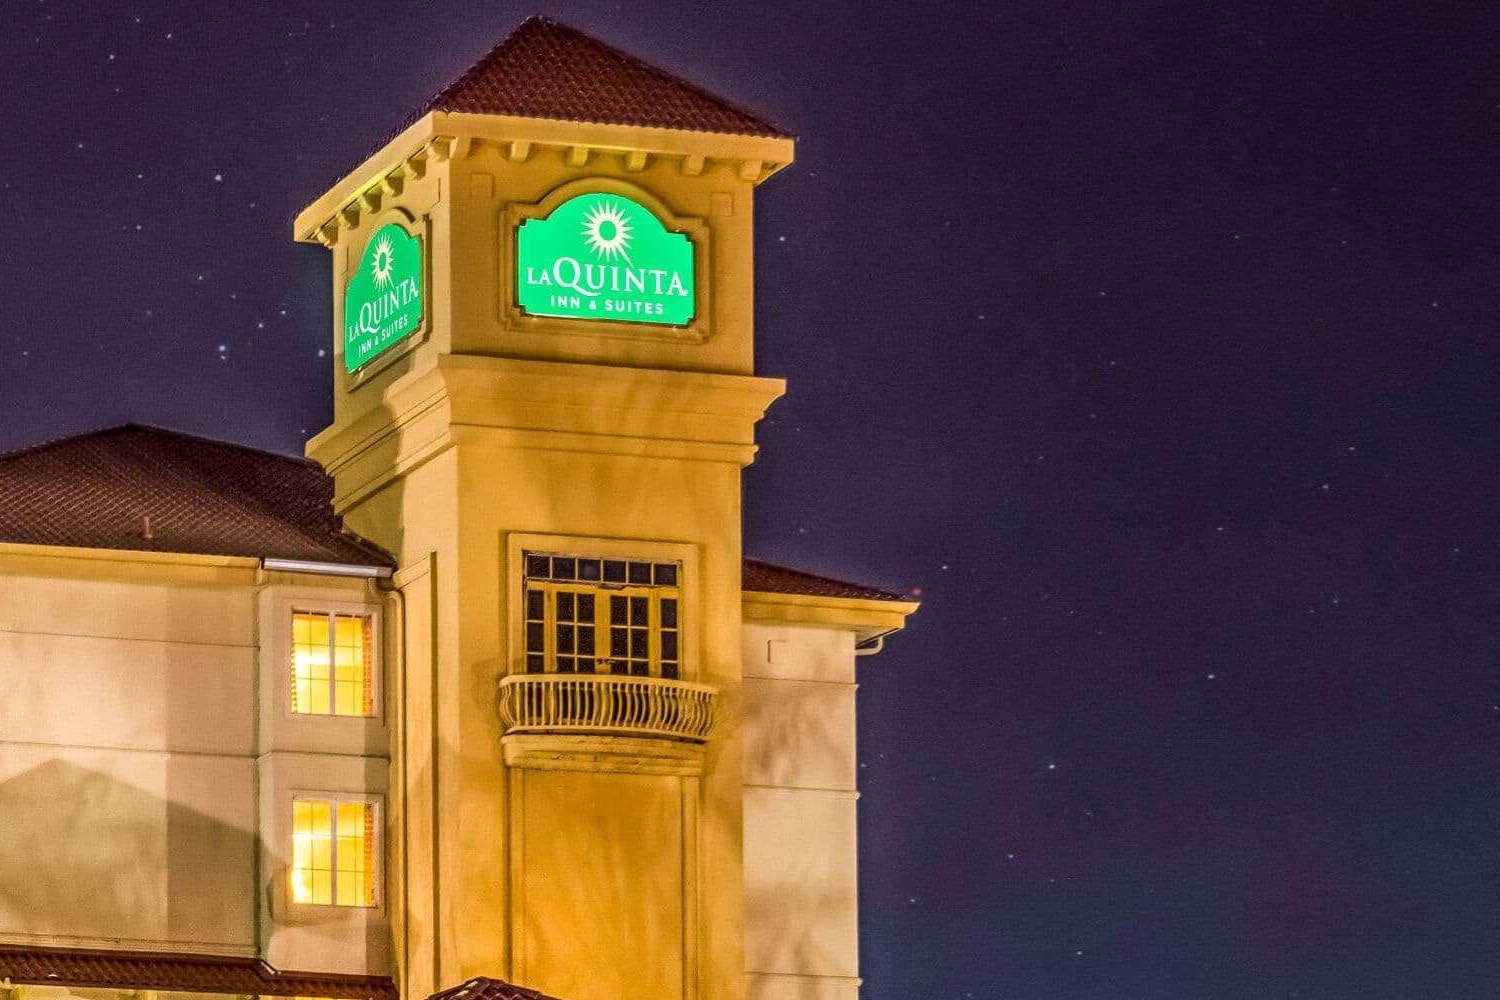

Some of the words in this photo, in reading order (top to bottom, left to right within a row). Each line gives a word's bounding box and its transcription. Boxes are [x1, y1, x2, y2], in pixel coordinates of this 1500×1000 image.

[550, 295, 581, 309] INN
[589, 300, 597, 310] &
[605, 300, 664, 315] SUITES
[358, 338, 372, 358] INN
[381, 314, 408, 342] SUITES
